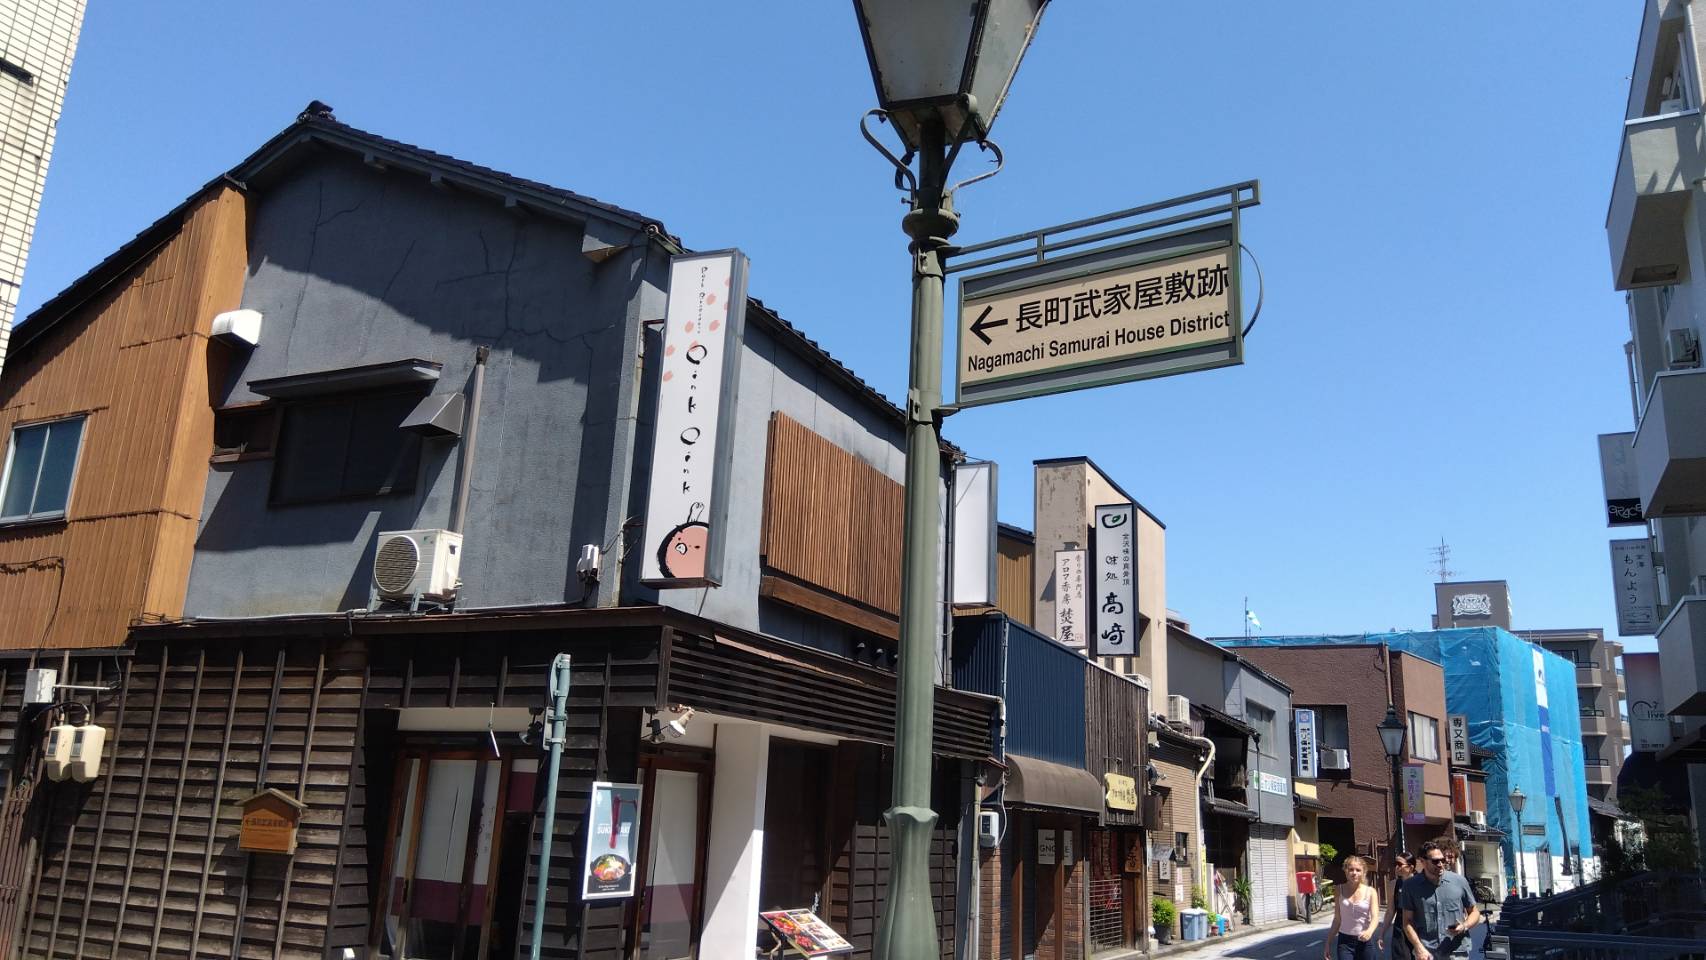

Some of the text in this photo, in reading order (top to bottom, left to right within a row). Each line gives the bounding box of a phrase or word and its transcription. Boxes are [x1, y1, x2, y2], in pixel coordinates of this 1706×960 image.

[1016, 264, 1229, 333] 長町武家屋敷跡
[967, 310, 1230, 373] Nagamachi Samurai House District
[686, 344, 708, 414] Oink
[680, 427, 701, 494] Oink
